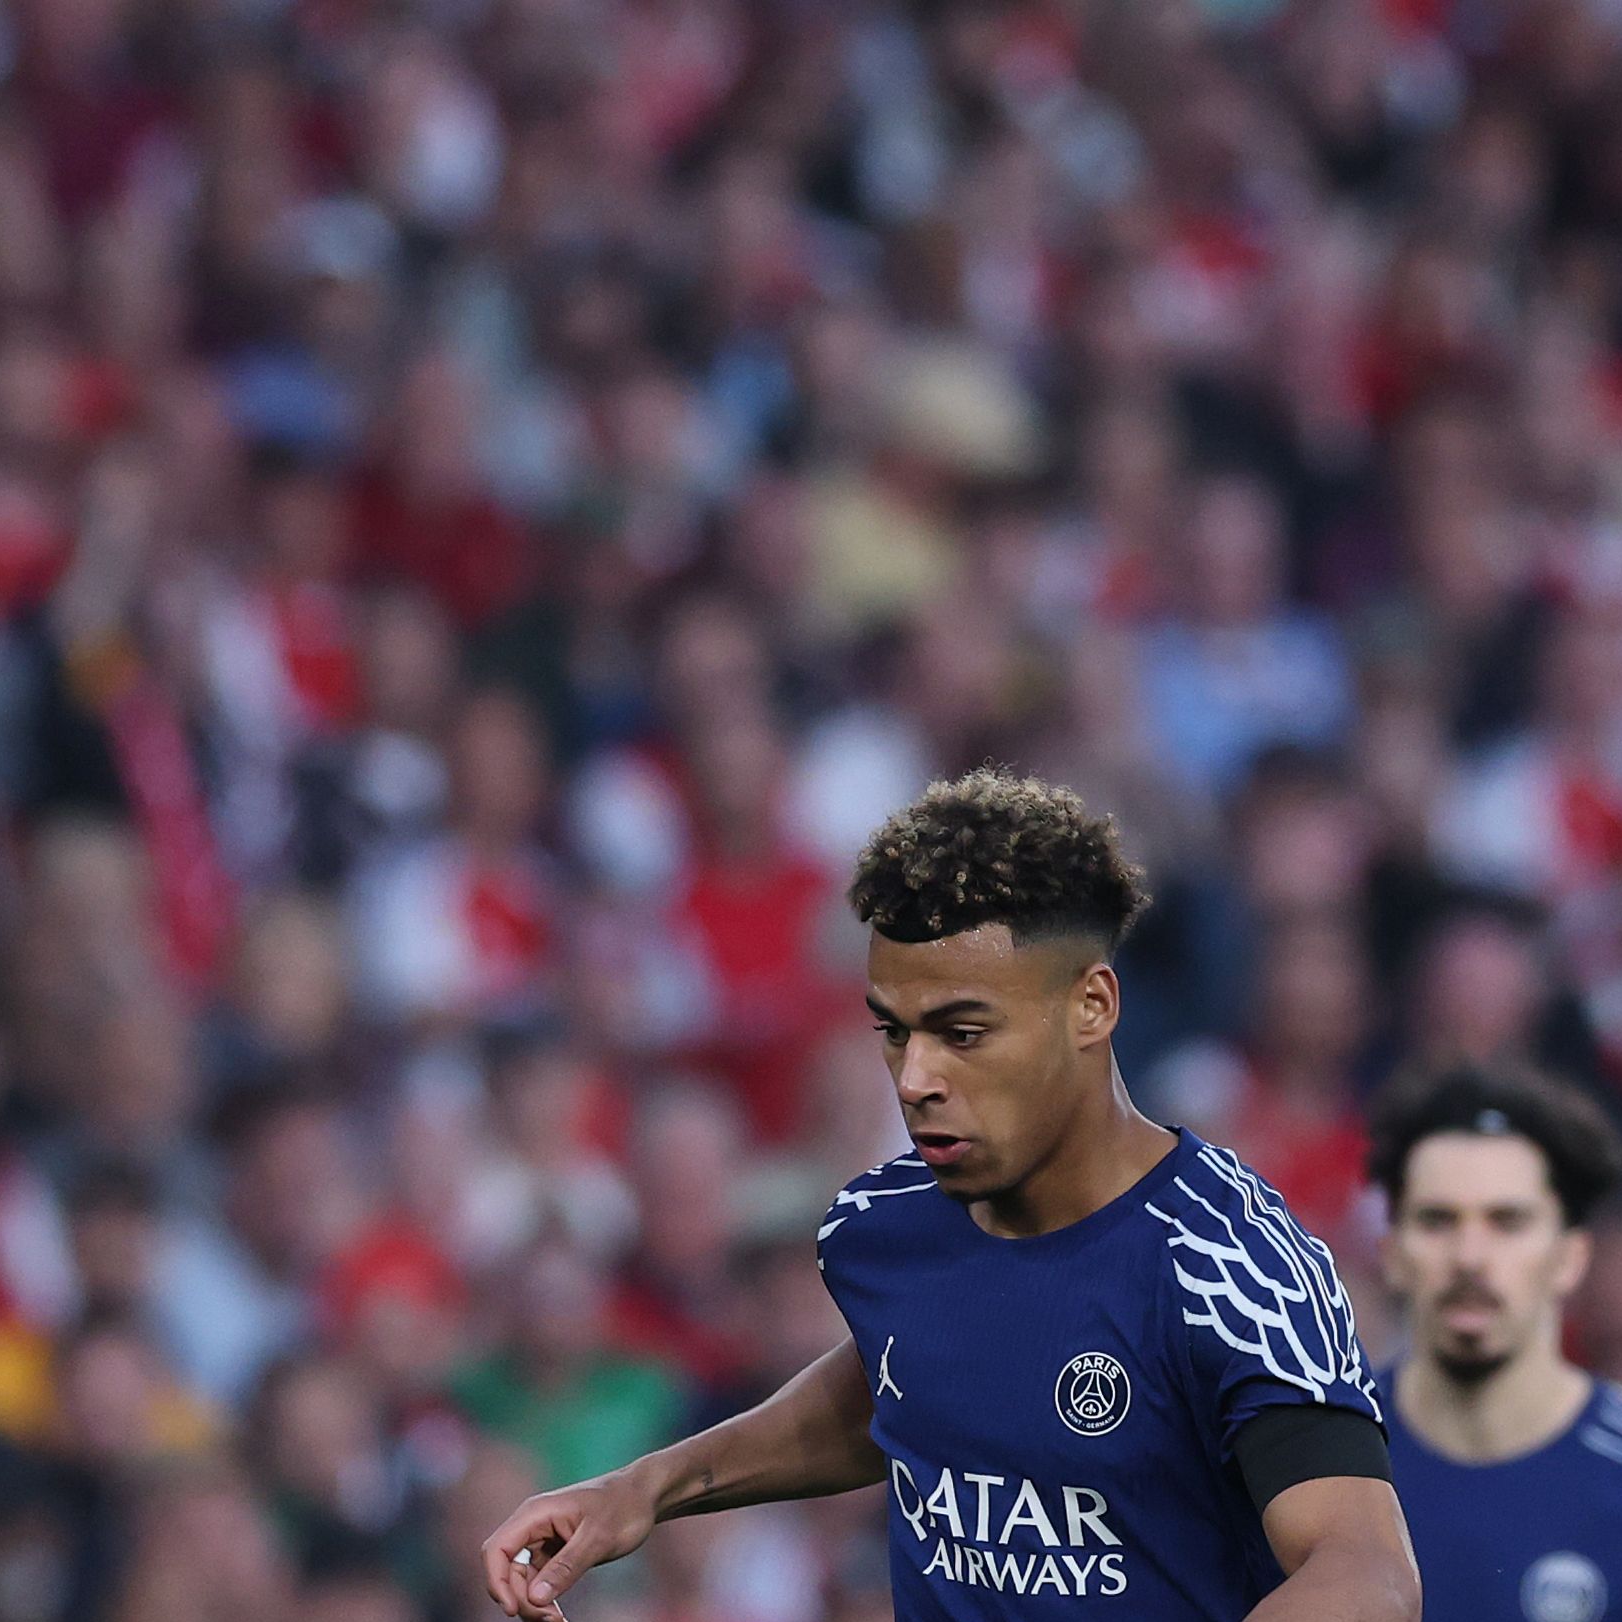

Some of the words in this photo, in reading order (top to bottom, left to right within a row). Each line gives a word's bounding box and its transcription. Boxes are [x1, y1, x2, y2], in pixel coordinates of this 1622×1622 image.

[1071, 1356, 1121, 1380] PARIS
[891, 1458, 1124, 1548] QATAR
[922, 1537, 1128, 1597] AIRWAYS
